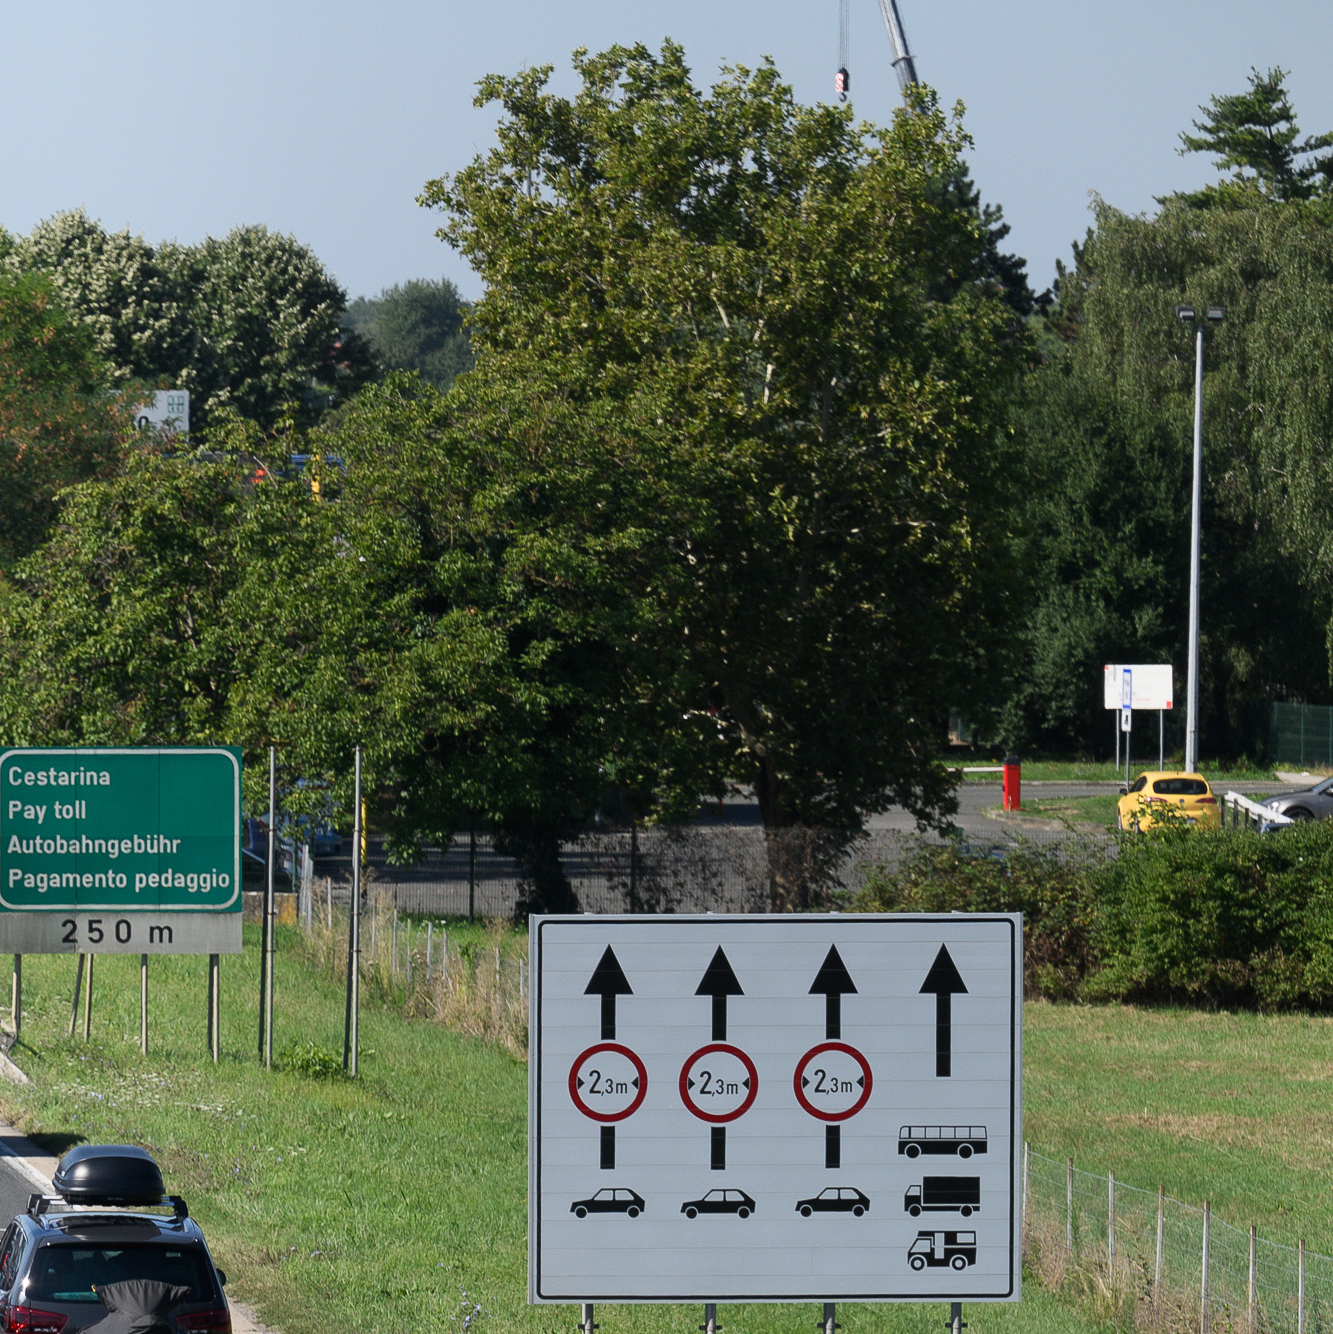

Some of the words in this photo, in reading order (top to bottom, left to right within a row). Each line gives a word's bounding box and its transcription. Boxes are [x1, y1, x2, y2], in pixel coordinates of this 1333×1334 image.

[8, 766, 111, 786] Cestarina
[8, 800, 47, 824] Pay
[54, 800, 87, 819] toll
[7, 834, 181, 859] Autobahngebühr
[8, 868, 128, 893] Pagamento
[134, 868, 230, 893] pedaggio
[61, 919, 132, 943] 250
[149, 924, 173, 943] m
